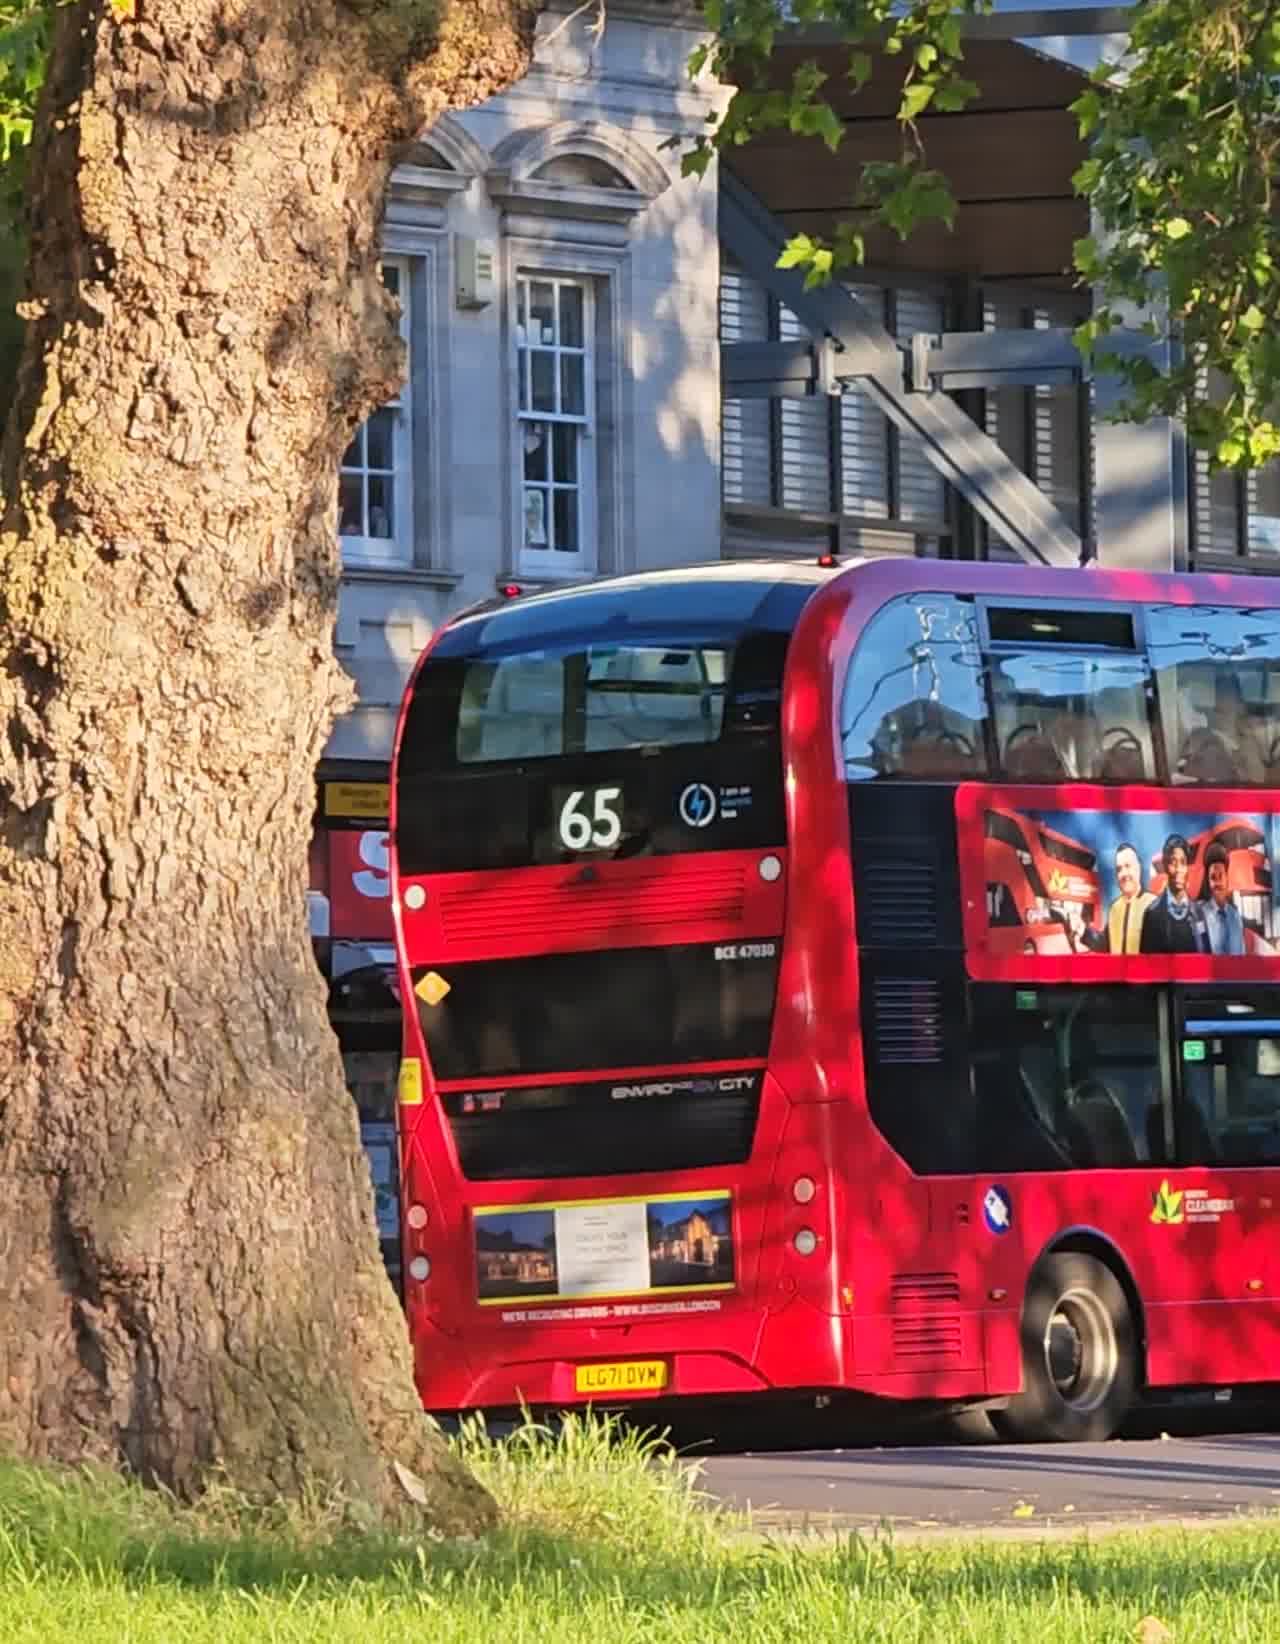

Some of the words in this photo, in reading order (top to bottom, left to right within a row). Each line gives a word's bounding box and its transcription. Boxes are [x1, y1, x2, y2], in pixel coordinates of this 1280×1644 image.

[559, 788, 622, 850] 65
[714, 945, 737, 961] BCE
[586, 1365, 623, 1388] LG71
[626, 1363, 657, 1386] DVM
